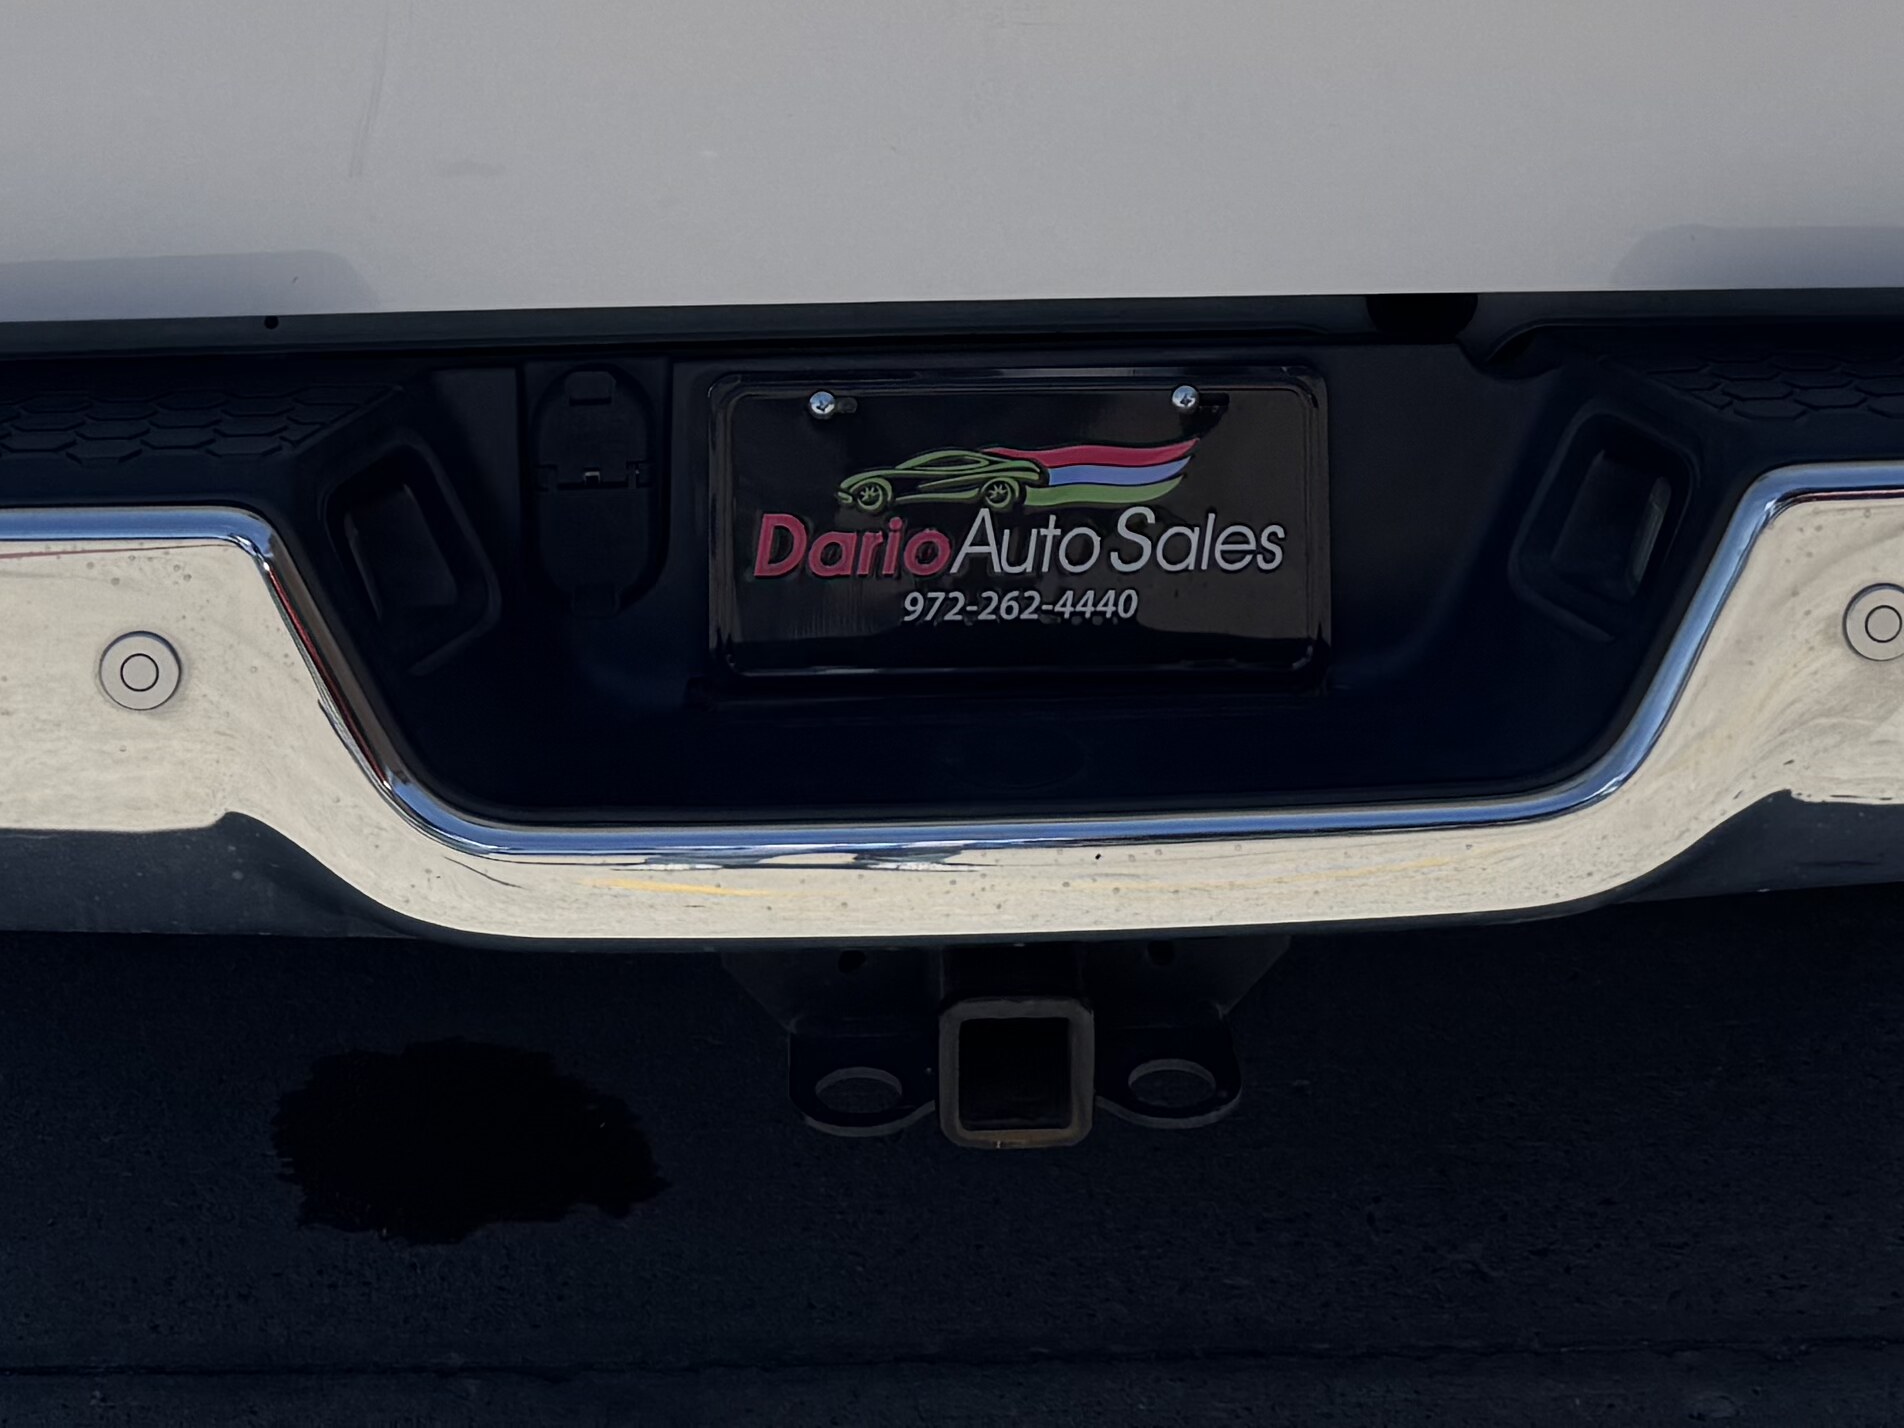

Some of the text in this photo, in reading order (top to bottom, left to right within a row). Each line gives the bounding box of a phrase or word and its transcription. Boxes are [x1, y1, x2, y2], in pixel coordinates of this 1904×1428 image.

[753, 506, 1285, 578] Dario Auto Sales
[902, 588, 1139, 622] 972-262-4440
